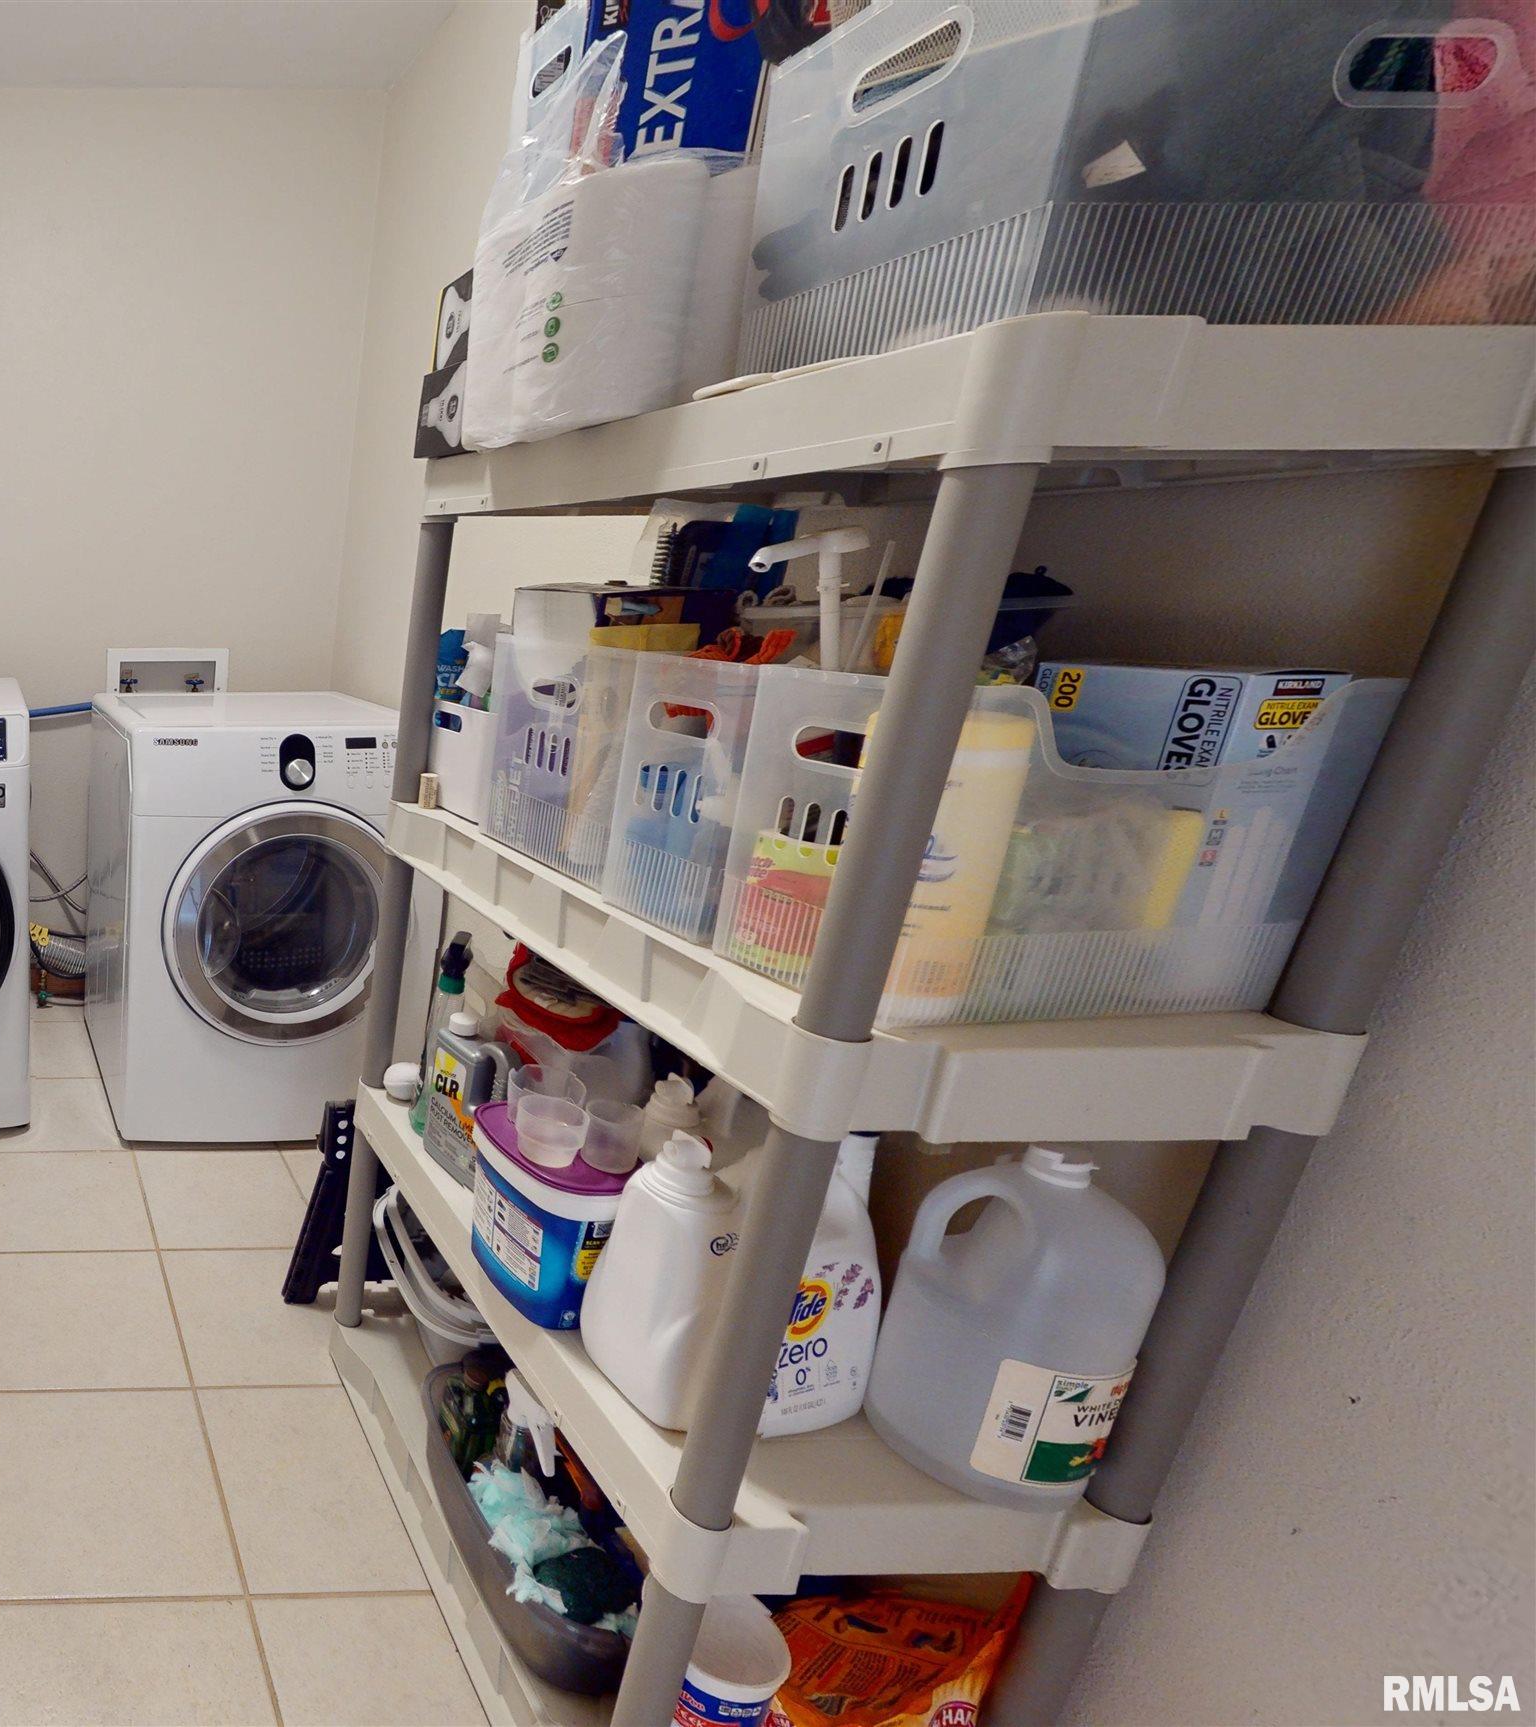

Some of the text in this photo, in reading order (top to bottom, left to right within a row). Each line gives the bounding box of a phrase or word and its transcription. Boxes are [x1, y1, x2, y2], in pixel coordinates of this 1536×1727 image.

[629, 0, 705, 158] EXTR
[1055, 671, 1081, 708] 200
[1277, 680, 1324, 690] KIRKLAND
[1204, 687, 1234, 737] NITRILE
[1266, 702, 1296, 710] NITRILE
[1258, 711, 1312, 726] GLOVE
[152, 737, 199, 747] SAMSUNG
[435, 1074, 459, 1098] CLR
[789, 1291, 827, 1326] Tide
[778, 1337, 828, 1369] zero
[1073, 1408, 1117, 1428] VINE
[1077, 1402, 1111, 1413] WHITE
